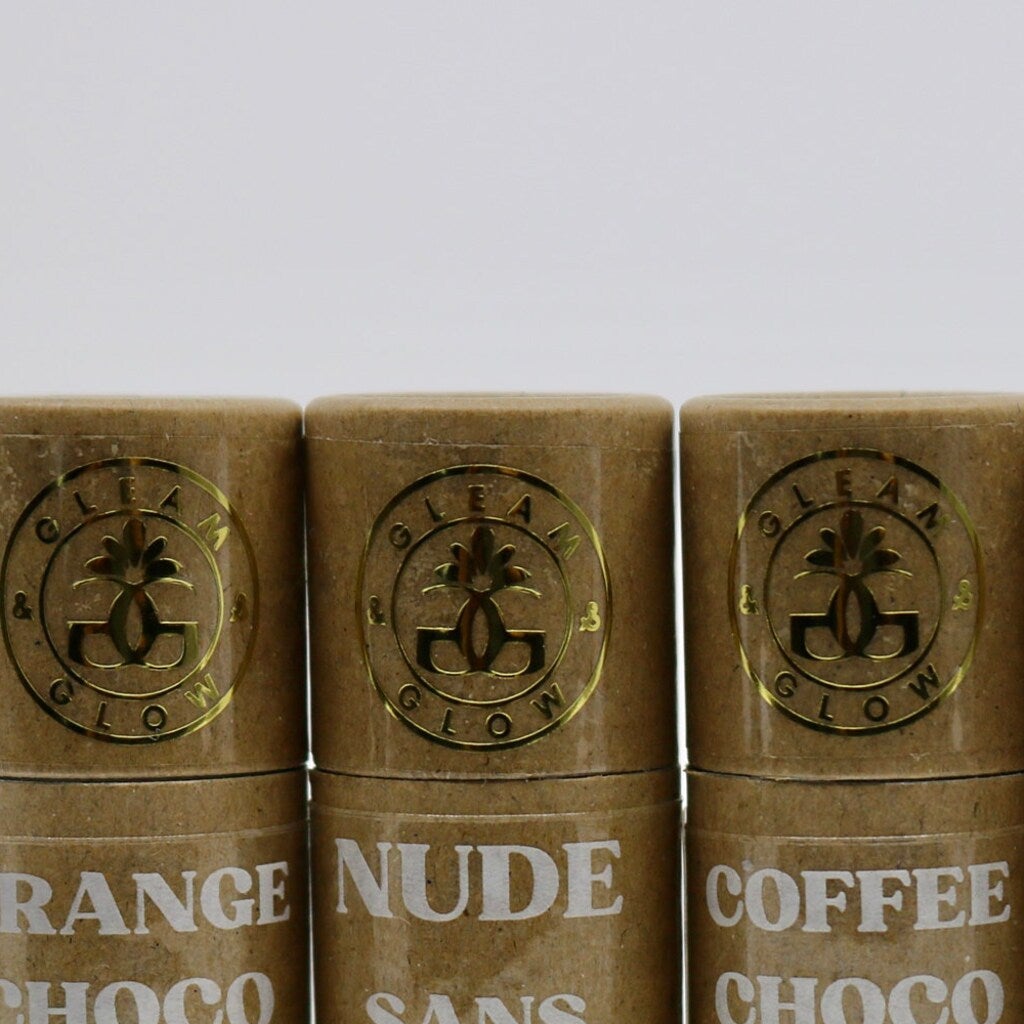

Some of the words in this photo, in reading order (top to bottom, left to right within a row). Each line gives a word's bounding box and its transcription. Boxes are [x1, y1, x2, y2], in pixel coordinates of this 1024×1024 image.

[35, 476, 231, 552] GLEAM
[389, 484, 581, 560] GLEAM
[758, 468, 950, 539] GLEAM
[49, 673, 220, 732] GLOW
[398, 682, 568, 737] GLOW
[774, 664, 940, 722] GLOW
[336, 839, 624, 922] NUDE
[706, 860, 1013, 933] COFFEE
